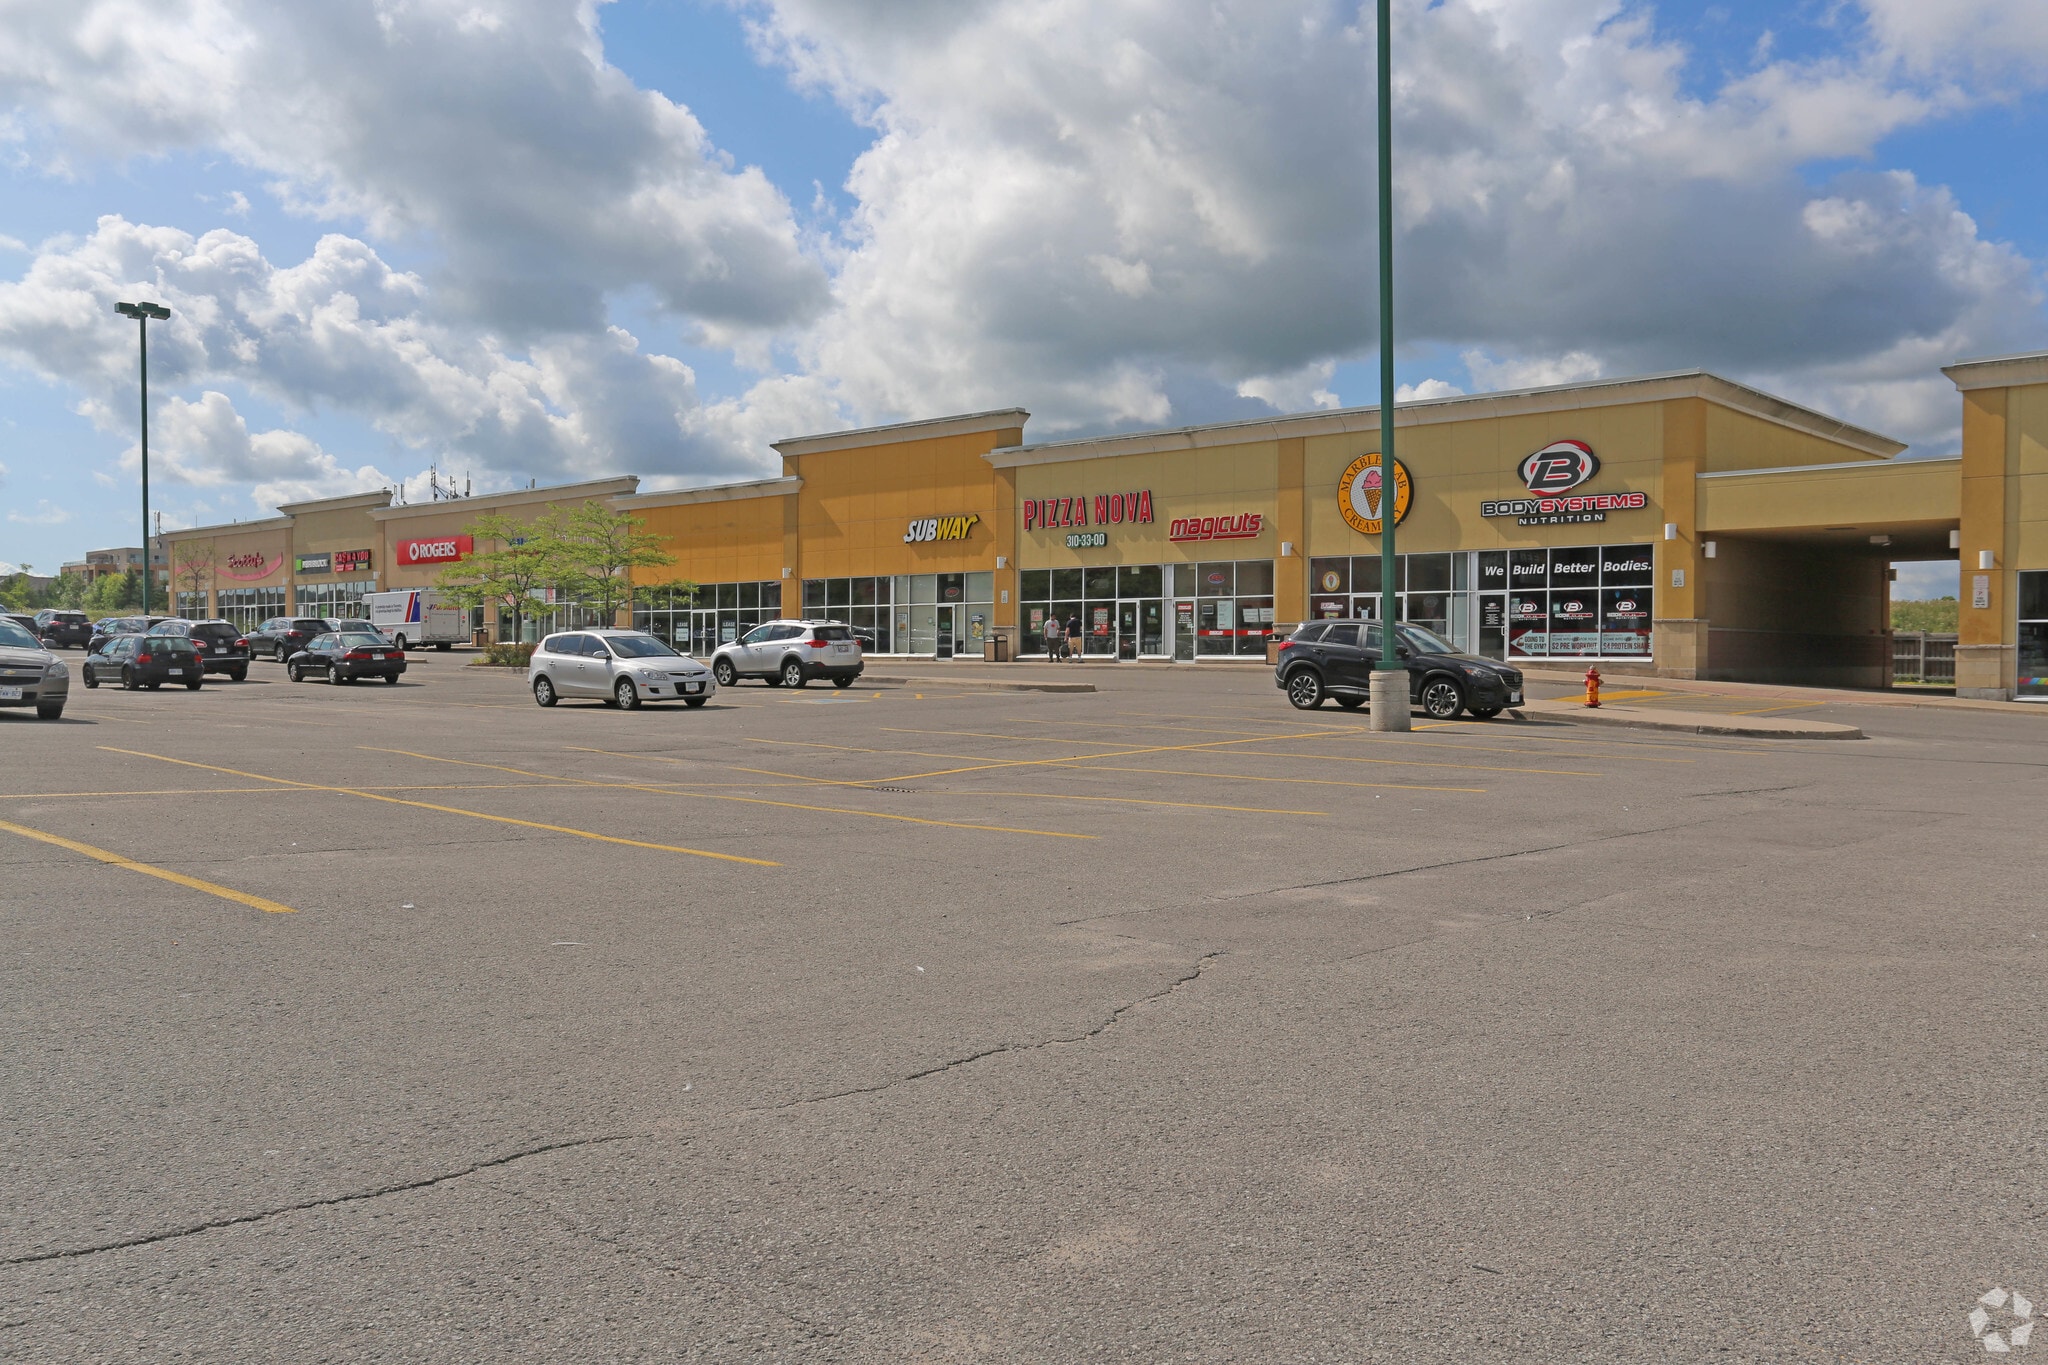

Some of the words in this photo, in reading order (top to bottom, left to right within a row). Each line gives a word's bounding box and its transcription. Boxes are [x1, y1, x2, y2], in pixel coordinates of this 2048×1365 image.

[1023, 496, 1087, 532] PIZZA
[1094, 489, 1154, 525] NOVA
[1482, 492, 1645, 516] BODYSYSTEMS
[1169, 512, 1262, 542] magicuts
[1519, 514, 1604, 525] NUTRITION
[903, 514, 979, 543] SUBWAY
[1066, 533, 1105, 547] 310-33-00
[357, 551, 369, 561] YOU
[419, 541, 457, 558] ROGERS
[1485, 566, 1504, 577] We
[1512, 564, 1546, 576] Build
[1554, 562, 1596, 574] Better
[1603, 560, 1652, 572] Bodies.
[1560, 642, 1571, 650] PRE
